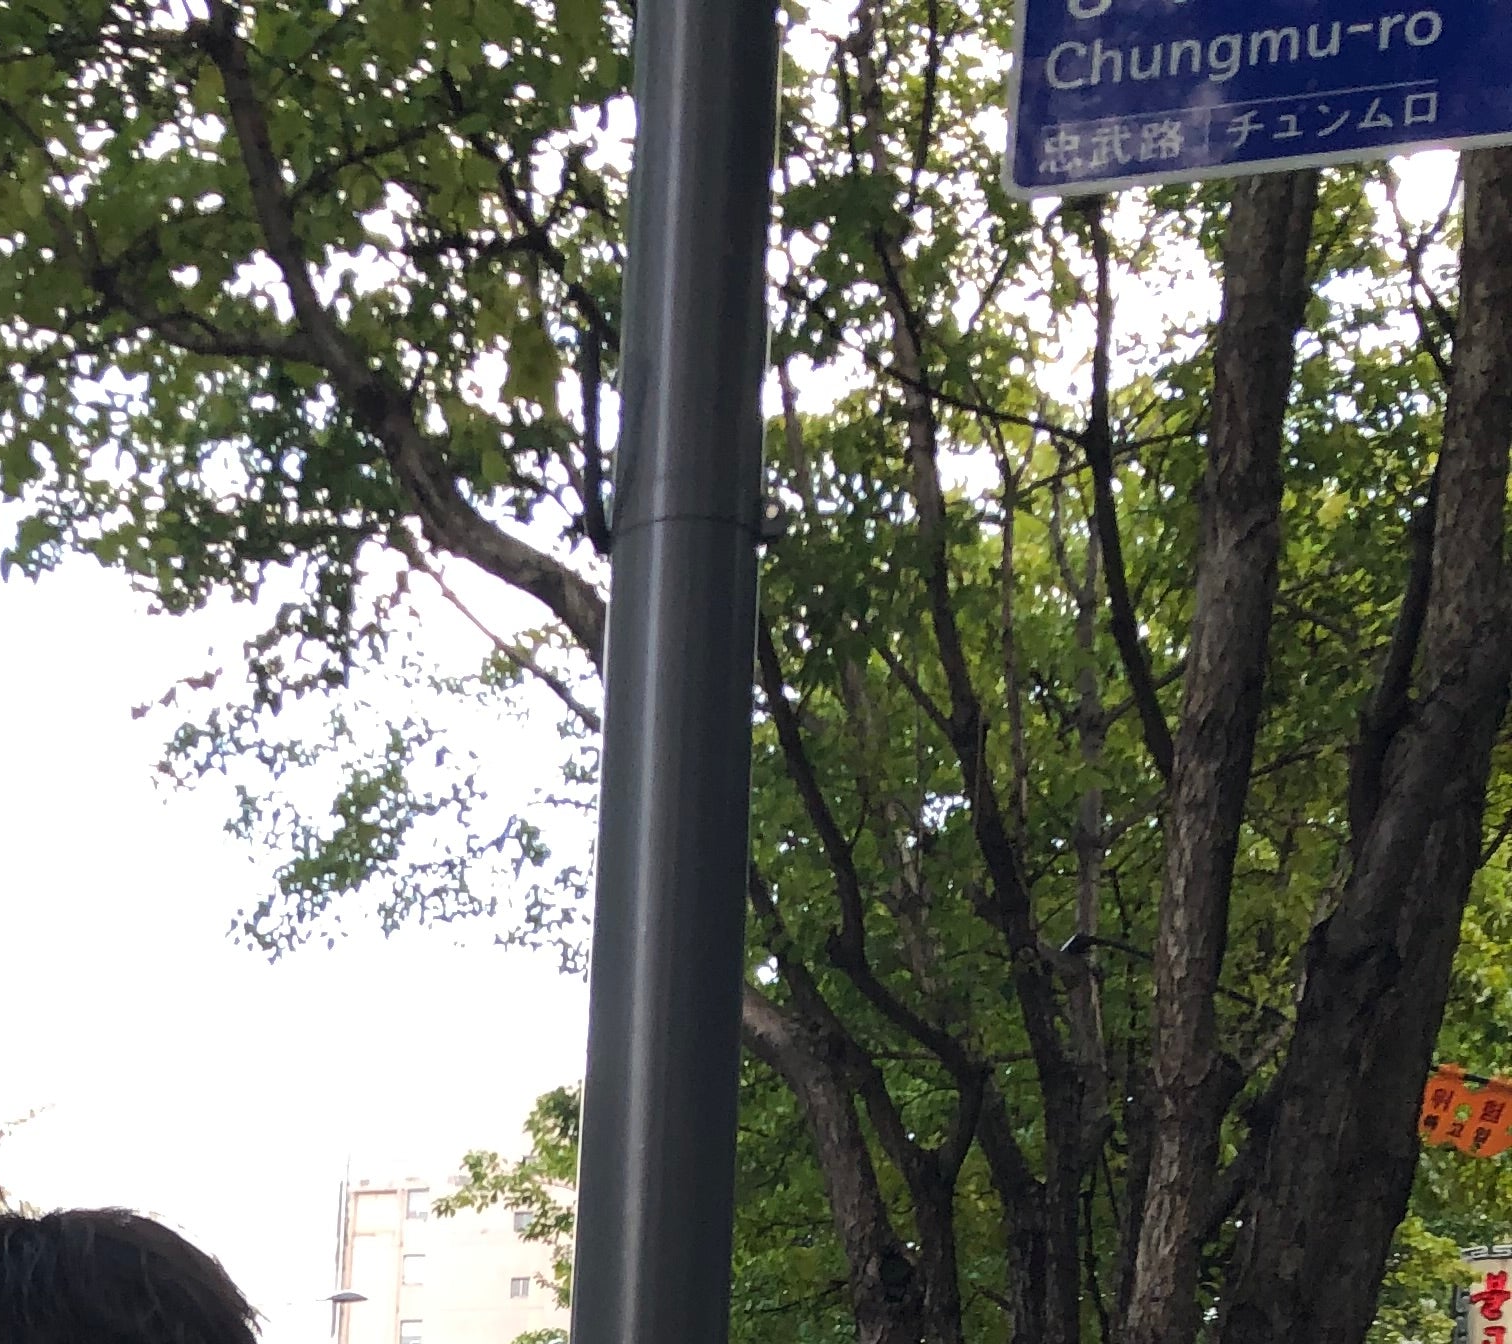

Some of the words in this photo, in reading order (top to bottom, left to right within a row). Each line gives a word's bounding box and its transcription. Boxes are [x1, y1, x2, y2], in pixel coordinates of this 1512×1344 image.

[1045, 10, 1443, 90] Chungmu-ro
[1039, 118, 1184, 175] 忠武路
[1226, 91, 1438, 148] チュンムロ
